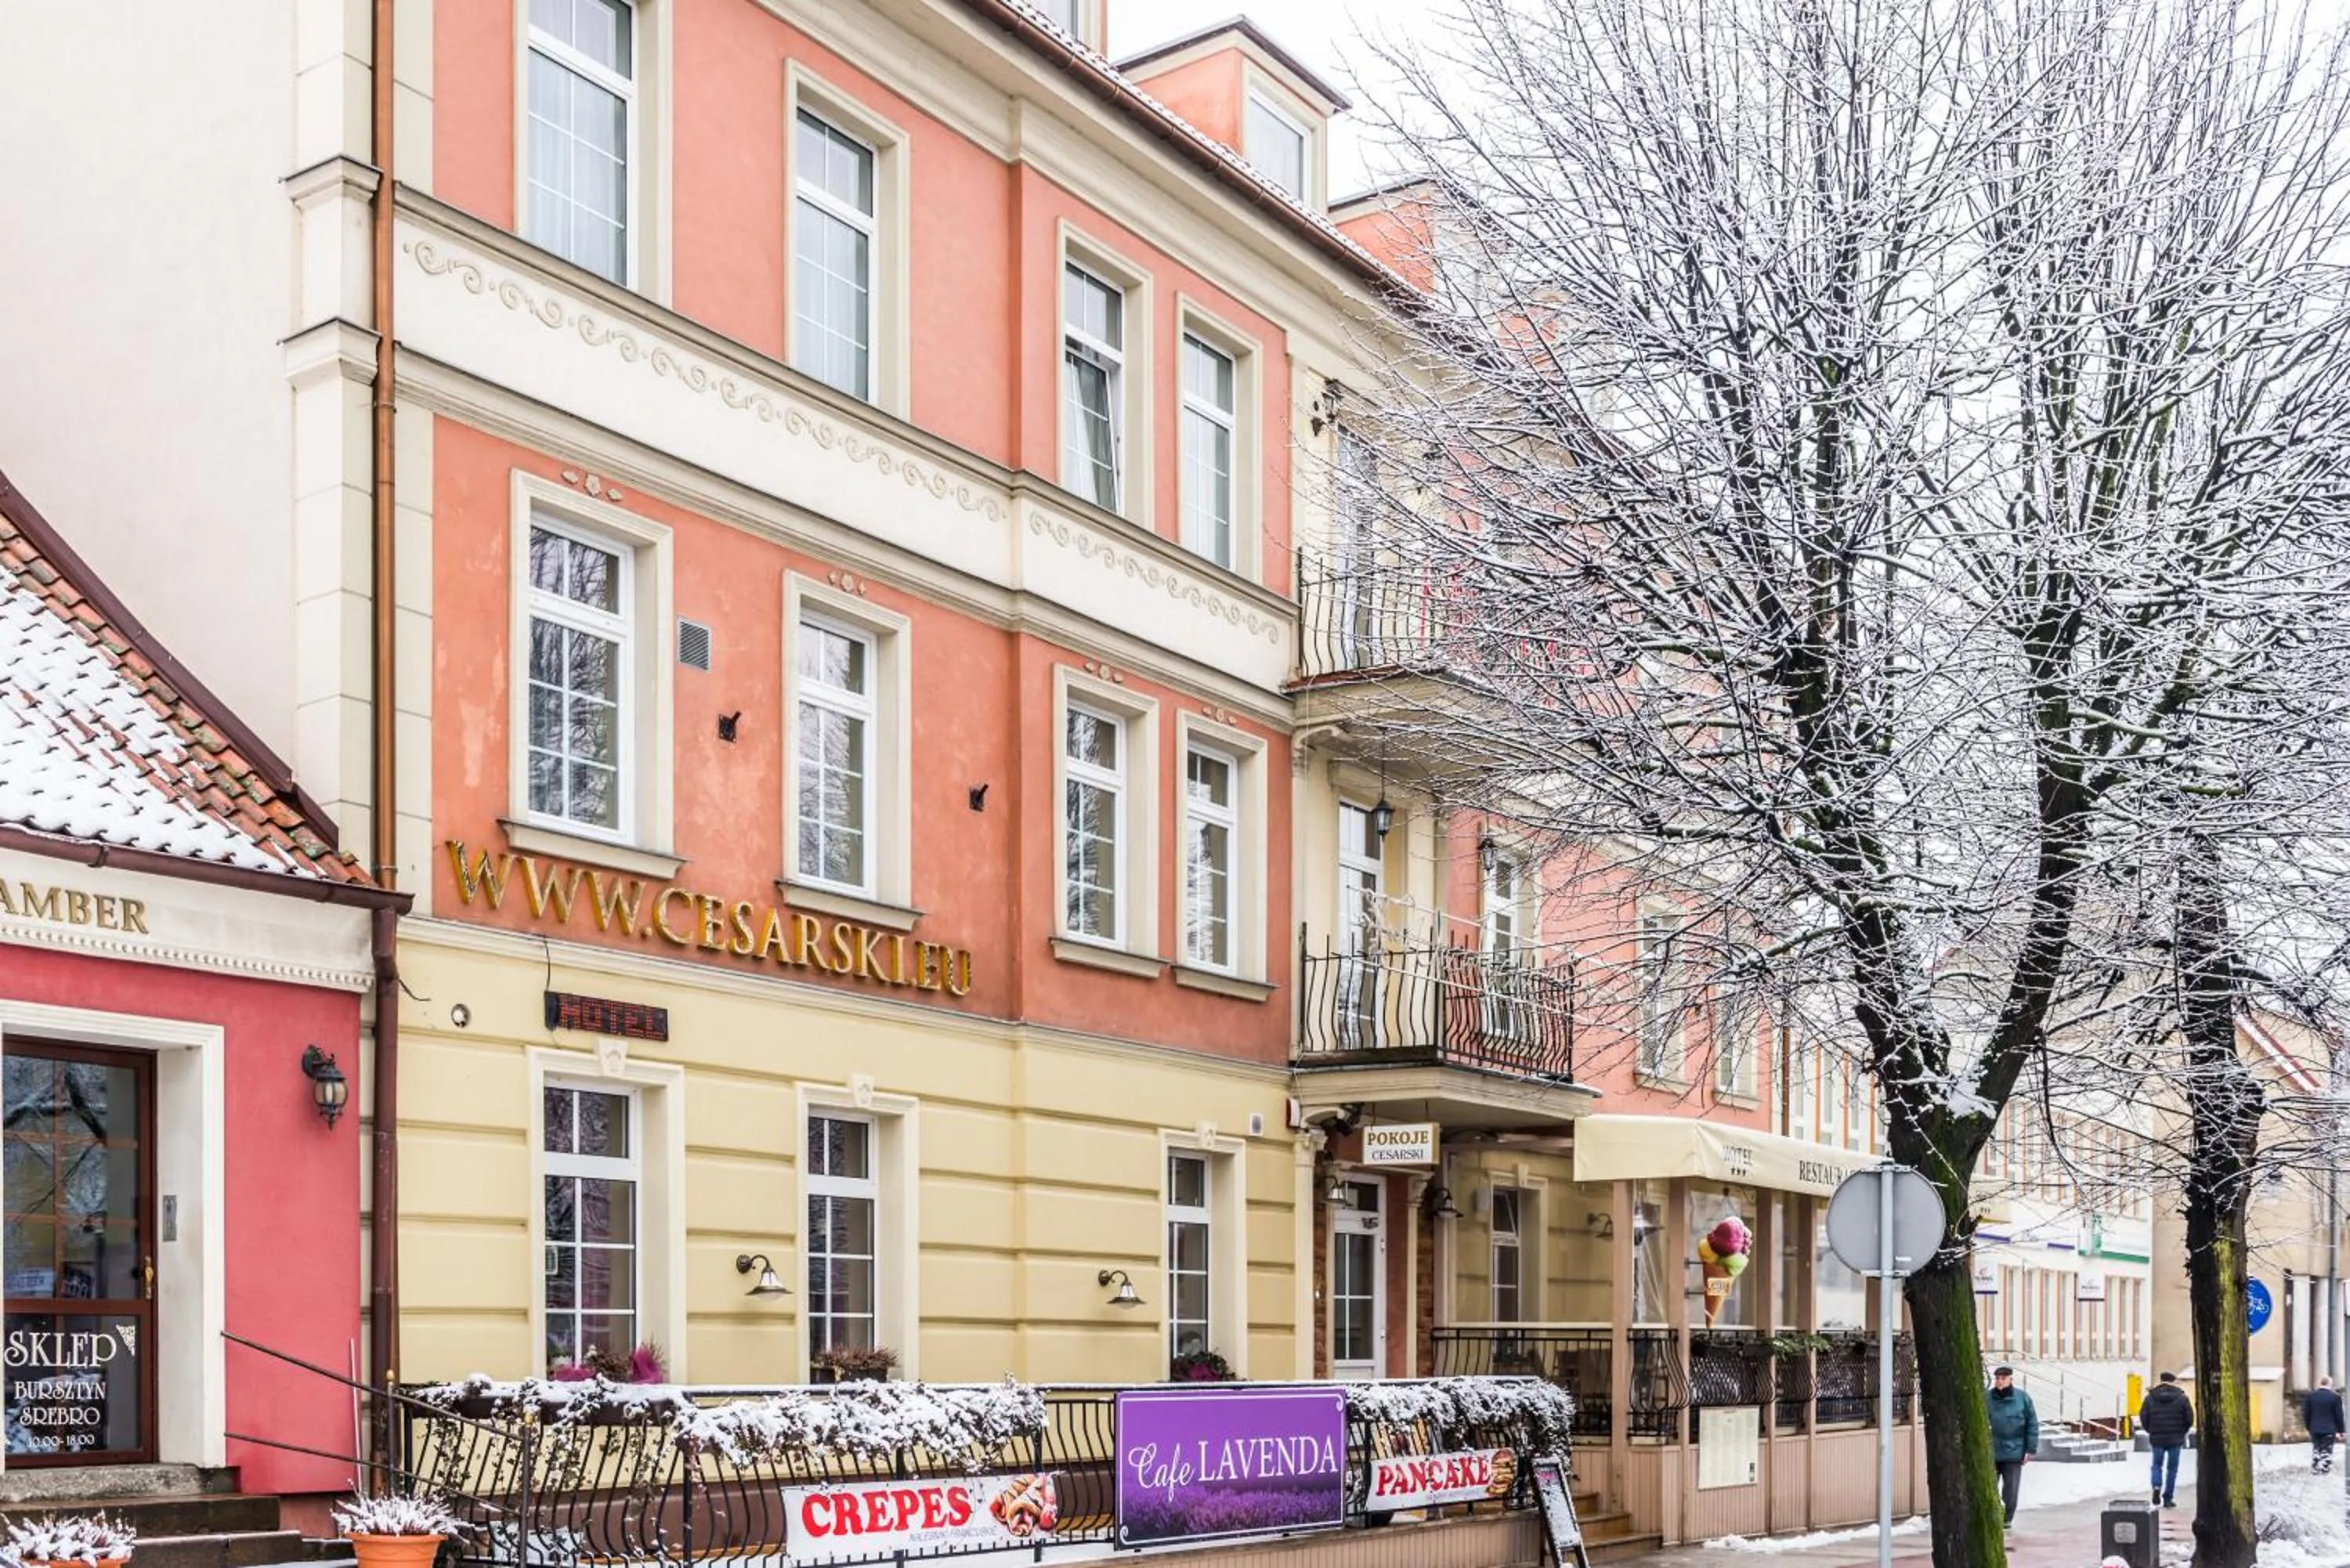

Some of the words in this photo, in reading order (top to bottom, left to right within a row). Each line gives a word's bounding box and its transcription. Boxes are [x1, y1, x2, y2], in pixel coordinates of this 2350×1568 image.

[445, 840, 974, 996] WWW.CESARSKI.EU
[559, 995, 666, 1041] HOTEL
[1367, 1130, 1429, 1146] POKOJE
[1372, 1148, 1424, 1161] CESARSKI
[1723, 1144, 1753, 1165] HOTEL
[4, 1330, 117, 1369] SKLEP
[13, 1381, 107, 1400] BURSZTYN
[20, 1406, 100, 1425] SREBRO
[1128, 1442, 1195, 1502] Cafe
[1198, 1434, 1339, 1482] LAVENDA
[1376, 1455, 1491, 1497] PANCAKE
[801, 1487, 973, 1538] CREPES
